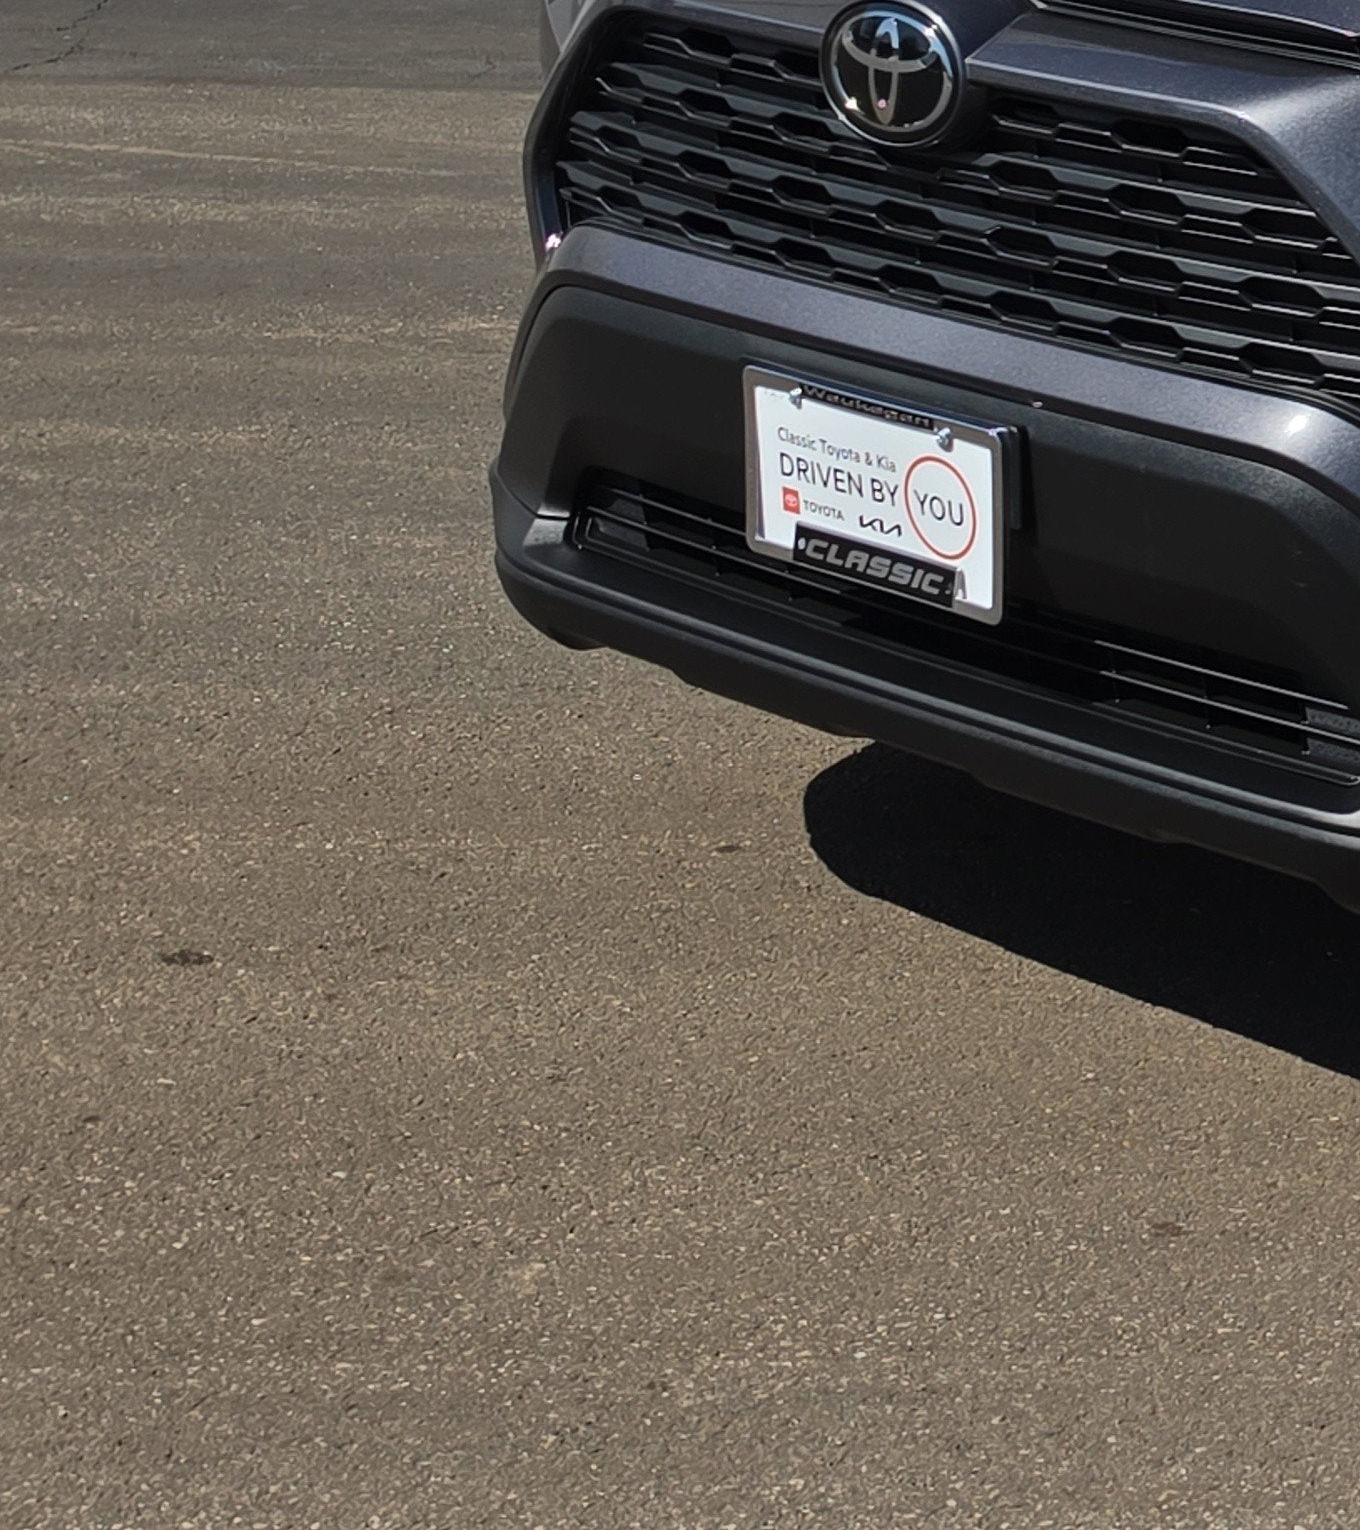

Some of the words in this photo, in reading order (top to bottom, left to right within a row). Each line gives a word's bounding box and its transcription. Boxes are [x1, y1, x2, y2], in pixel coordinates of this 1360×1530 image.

[802, 384, 930, 427] Waukegan
[777, 427, 816, 451] Classic
[820, 438, 860, 463] Toyota
[864, 453, 873, 466] &
[876, 455, 897, 472] Kia
[780, 452, 864, 497] DRIVEN
[871, 478, 899, 507] BY
[914, 489, 964, 526] YOU
[803, 499, 844, 521] TOYOTA
[805, 538, 944, 595] CLASSIC
